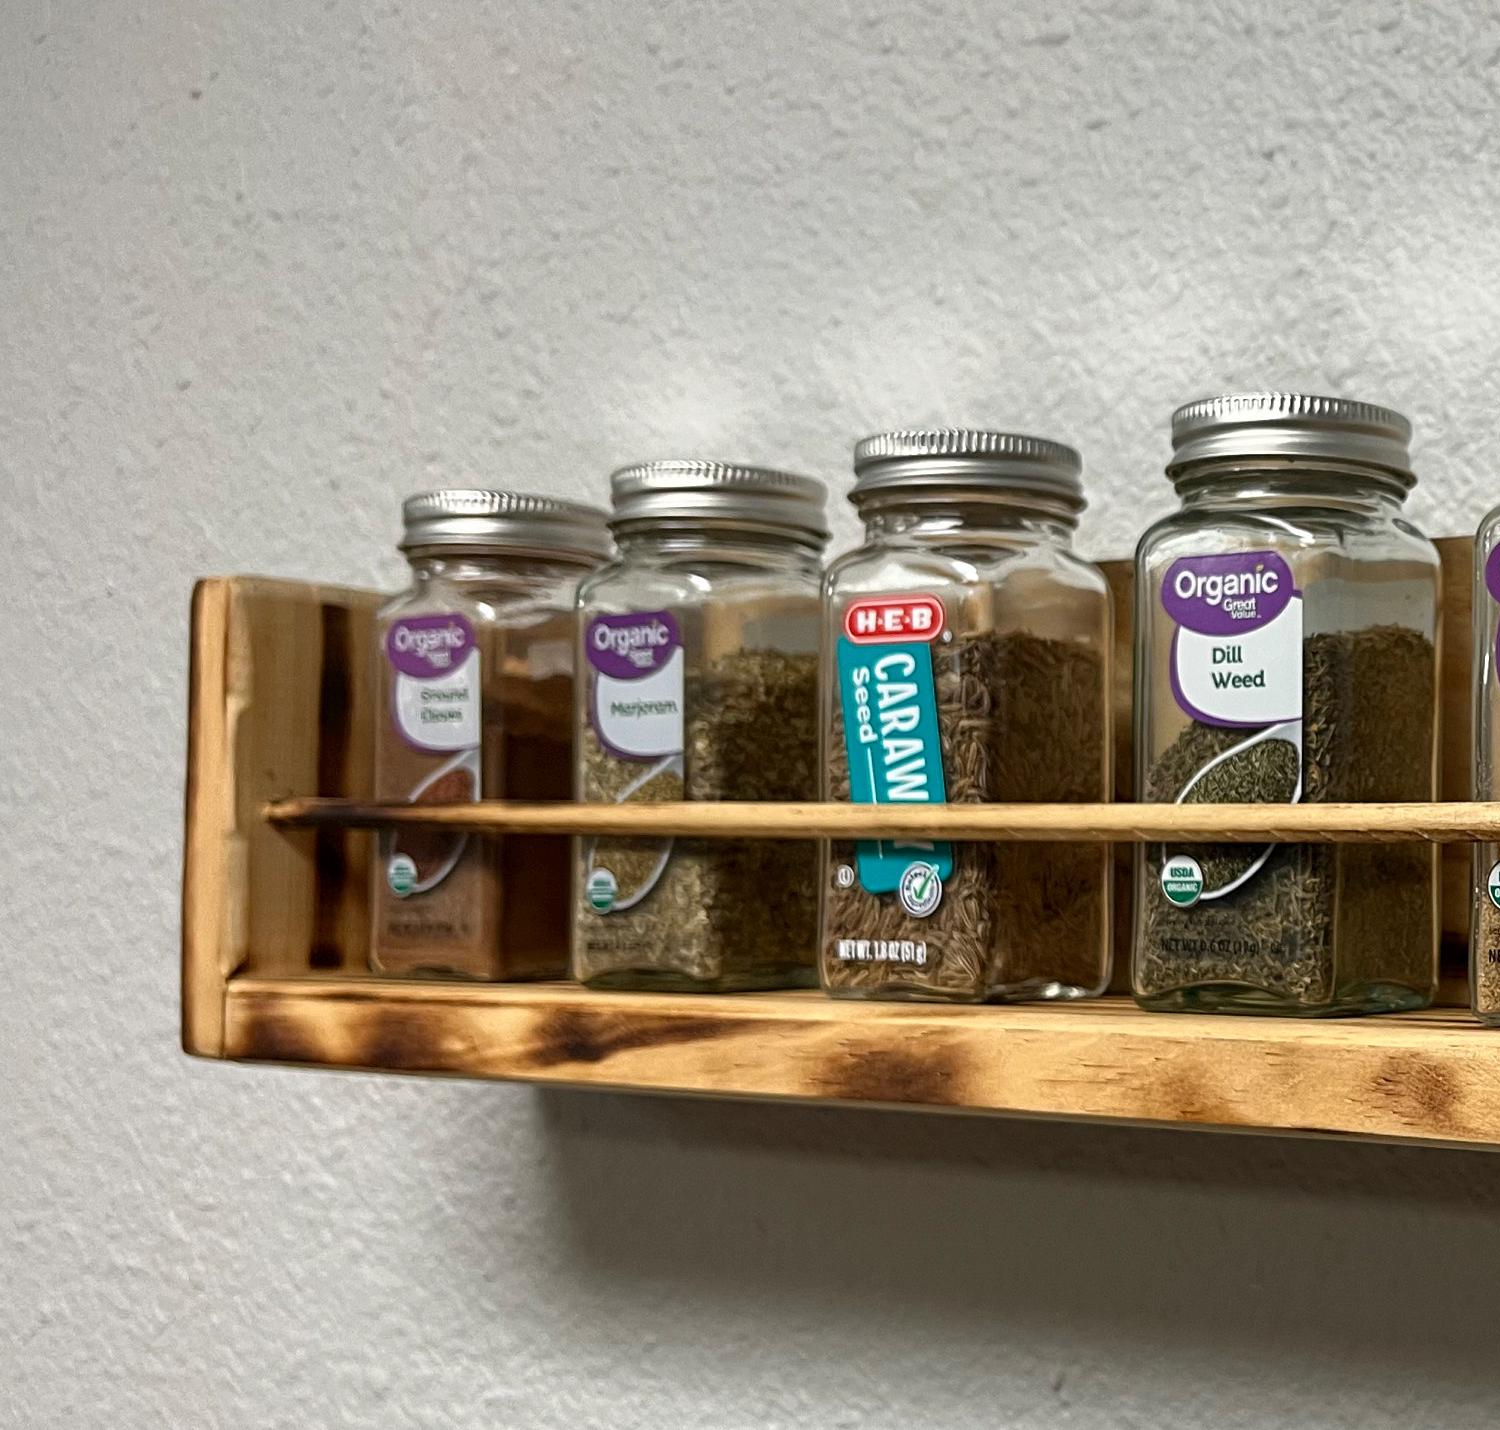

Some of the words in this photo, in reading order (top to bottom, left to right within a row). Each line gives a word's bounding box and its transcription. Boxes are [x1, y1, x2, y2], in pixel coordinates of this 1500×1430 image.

[1175, 564, 1279, 605] Organic
[1223, 597, 1256, 611] Great
[595, 620, 669, 656] Organic
[1212, 645, 1243, 664] Dill
[1211, 670, 1265, 689] Weed
[853, 666, 878, 744] Seed
[874, 653, 934, 850] CARAW
[1170, 867, 1194, 878] USDA
